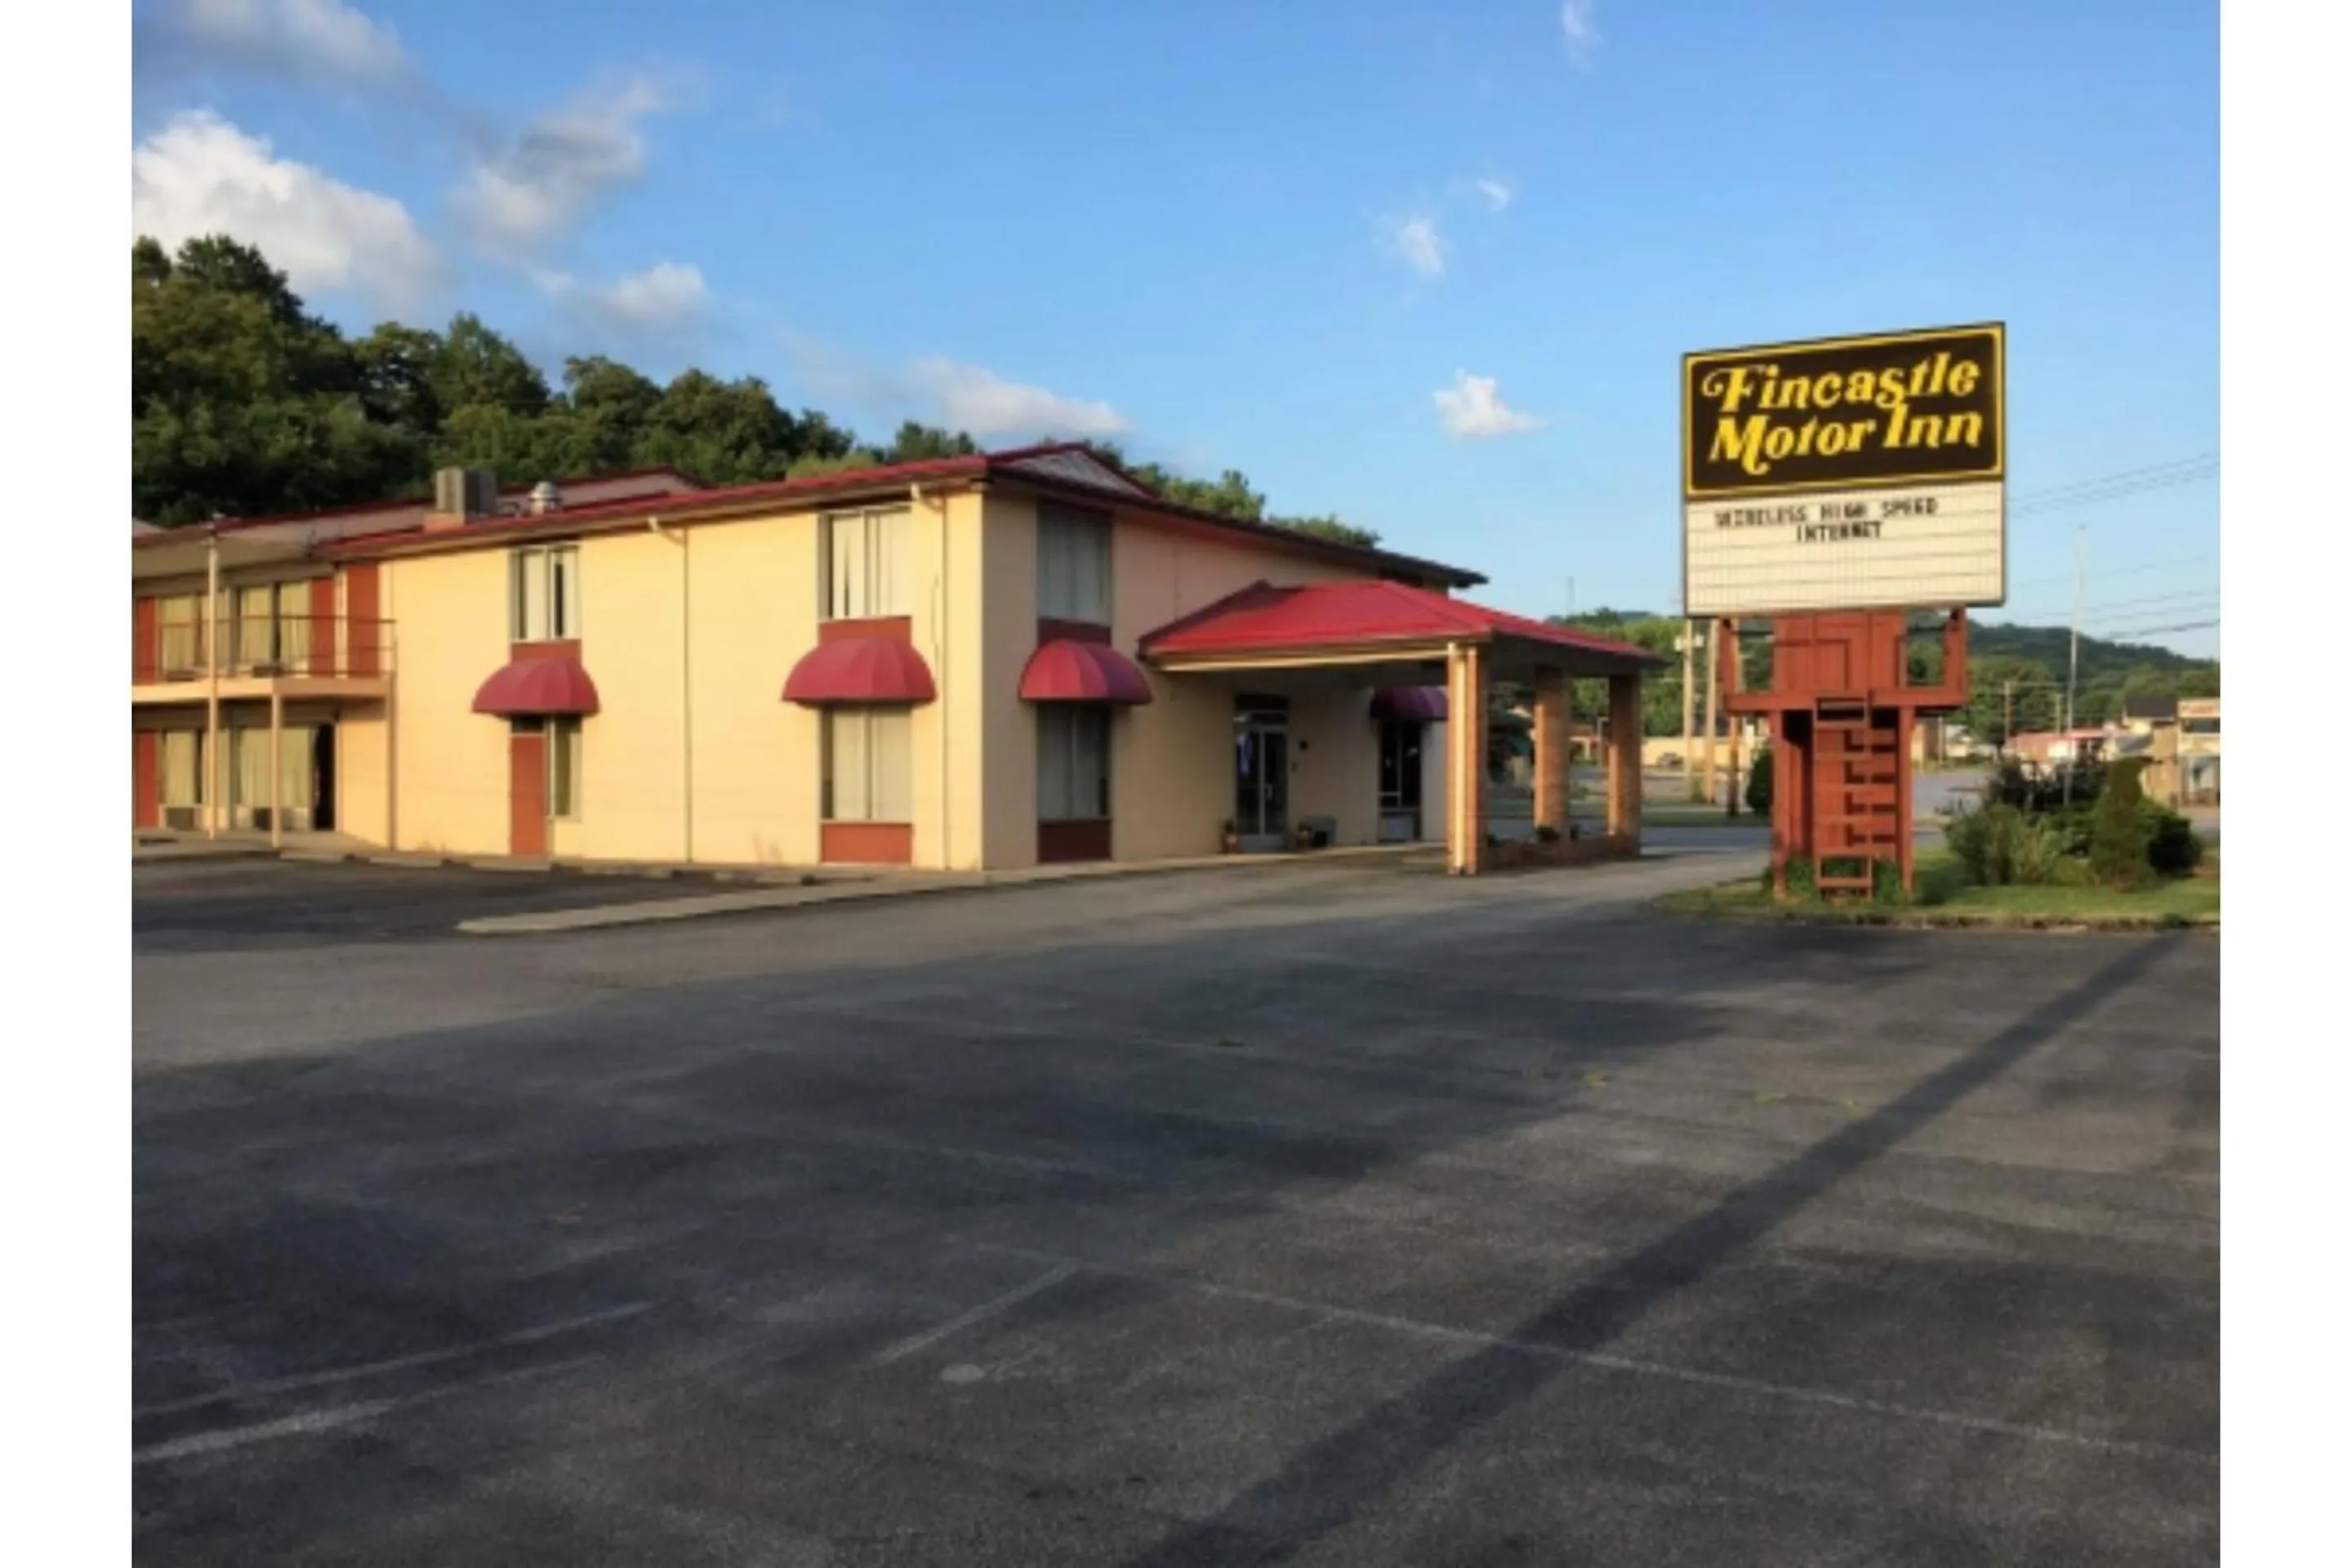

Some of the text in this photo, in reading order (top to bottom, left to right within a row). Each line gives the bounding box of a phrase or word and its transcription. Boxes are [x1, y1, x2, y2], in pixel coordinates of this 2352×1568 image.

[1701, 353, 1980, 411] Fincastle
[1709, 404, 1983, 475] Motor Inn
[1820, 502, 1867, 521] HIGH
[1882, 497, 1938, 517] SPEED
[1797, 521, 1882, 543] INTERNET
